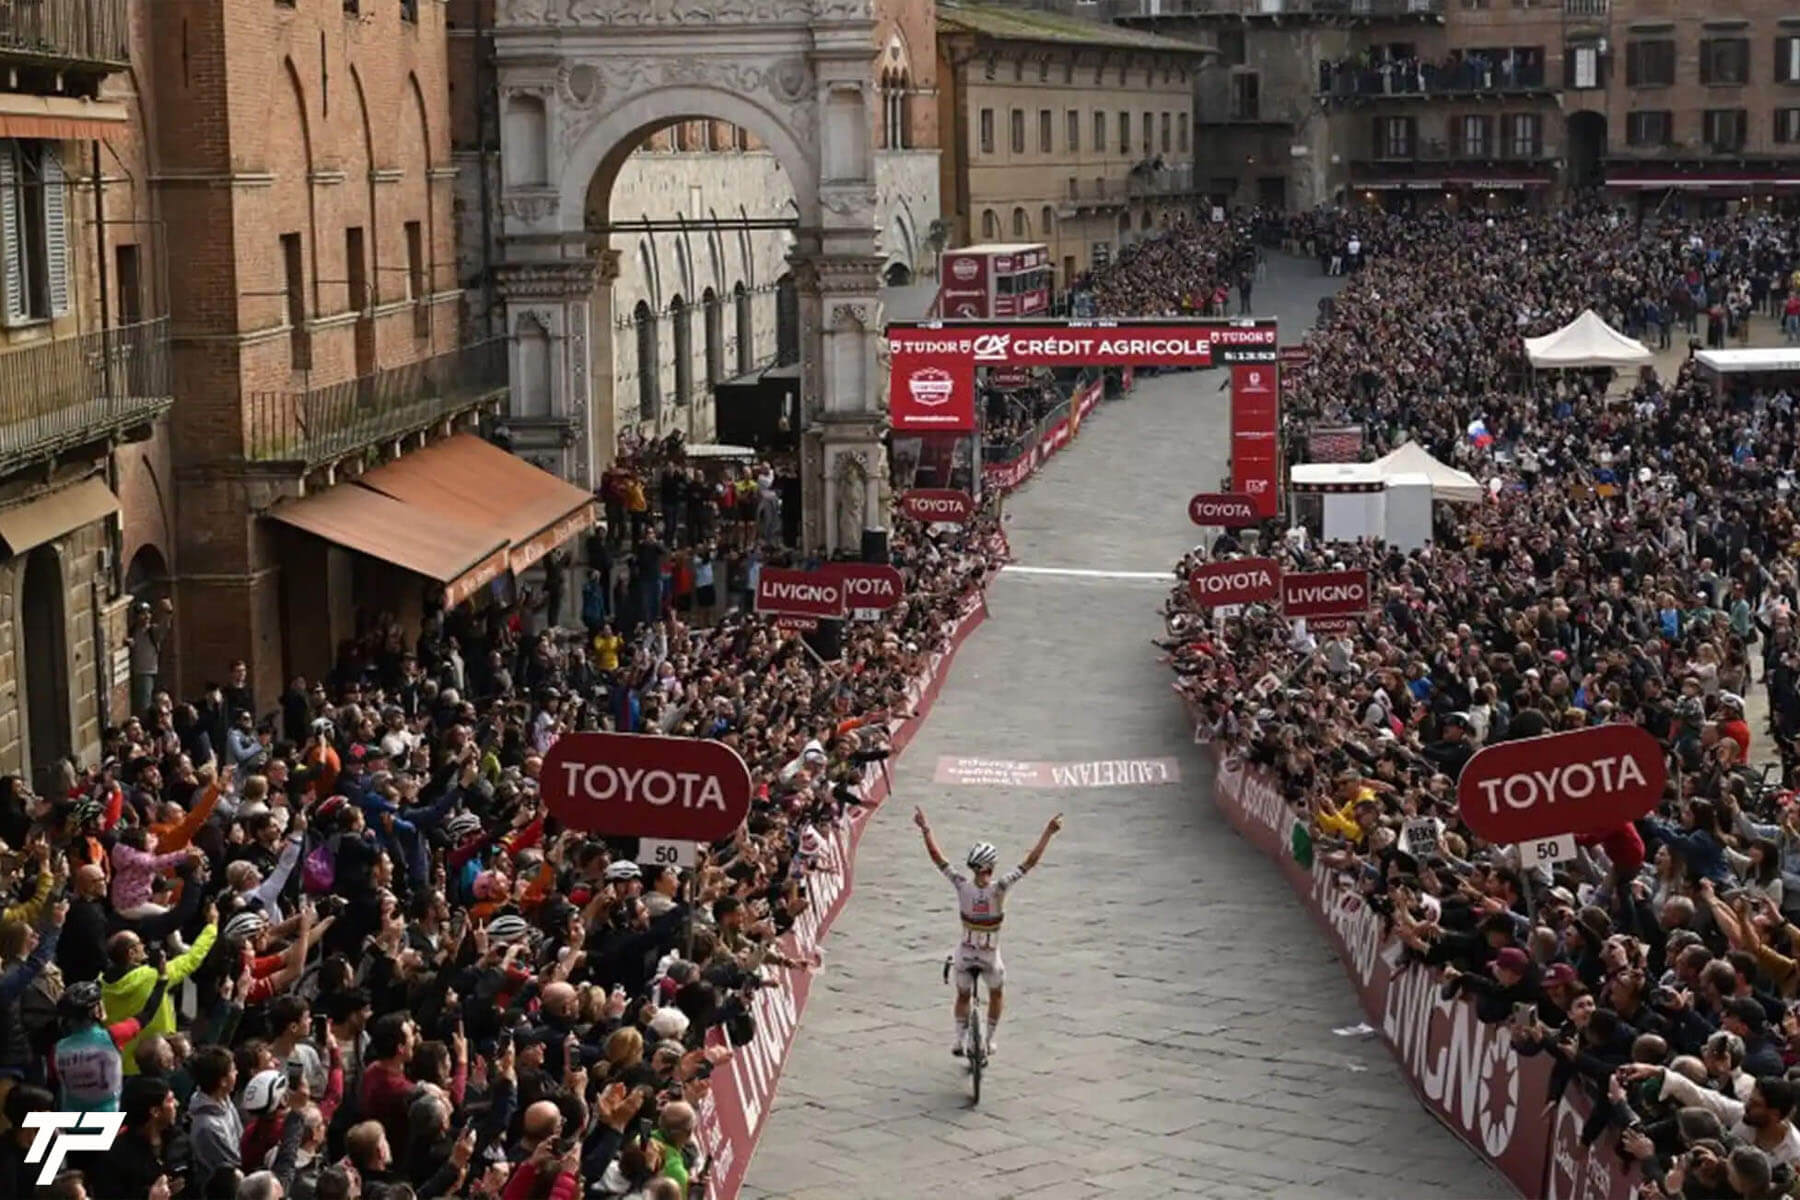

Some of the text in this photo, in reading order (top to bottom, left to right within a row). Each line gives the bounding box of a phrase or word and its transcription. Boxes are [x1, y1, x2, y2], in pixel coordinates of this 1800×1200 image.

[1013, 336, 1094, 355] CRÉDIT
[1097, 338, 1210, 356] AGRICOLE
[1222, 331, 1264, 343] TUDOR
[904, 340, 958, 354] TUDOR
[908, 497, 964, 513] TOYOTA
[1196, 501, 1251, 517] TOYOTA
[844, 578, 894, 596] YOTA
[1197, 570, 1273, 594] TOYOTA
[762, 581, 838, 603] LIVIGNO
[1287, 583, 1364, 604] LIVIGNO
[1050, 759, 1168, 786] LAURETANA
[561, 761, 727, 812] TOYOTA
[1478, 754, 1648, 814] TOYOTA
[655, 846, 679, 864] 50
[1536, 841, 1559, 860] 50
